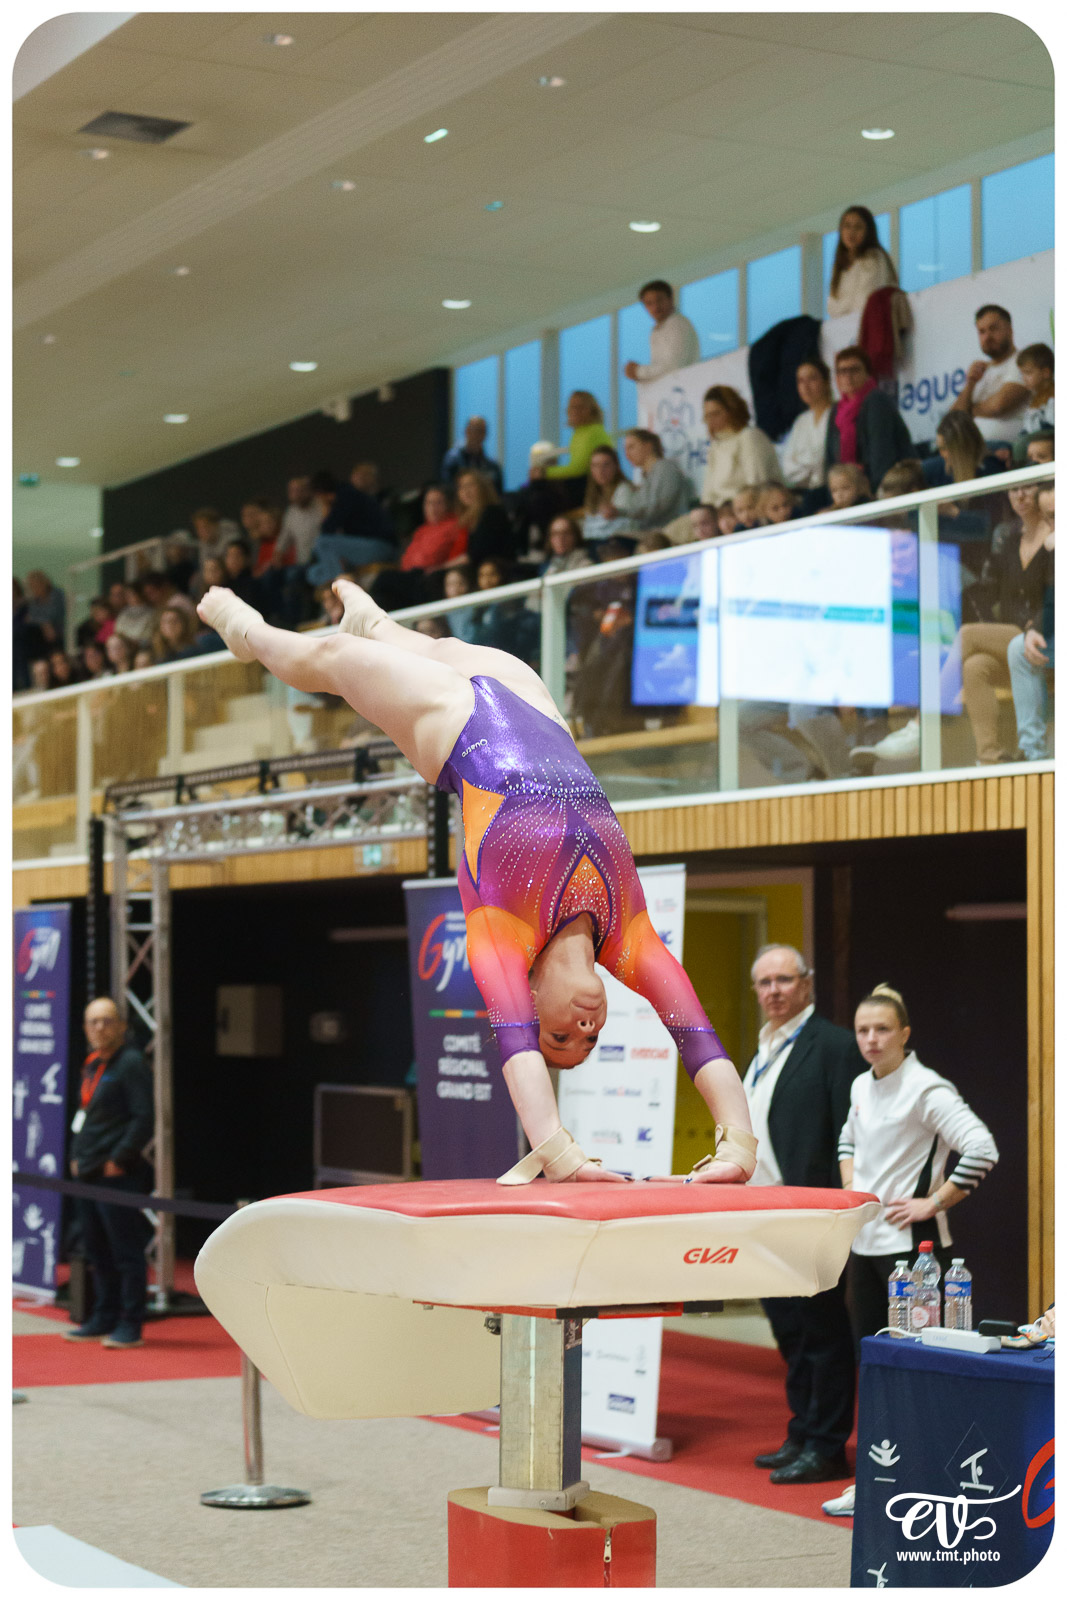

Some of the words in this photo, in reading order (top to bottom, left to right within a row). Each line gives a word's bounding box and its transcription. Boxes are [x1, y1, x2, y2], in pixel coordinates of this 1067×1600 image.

[901, 367, 967, 415] ague
[461, 738, 488, 758] Quatro
[682, 1245, 740, 1265] GVA
